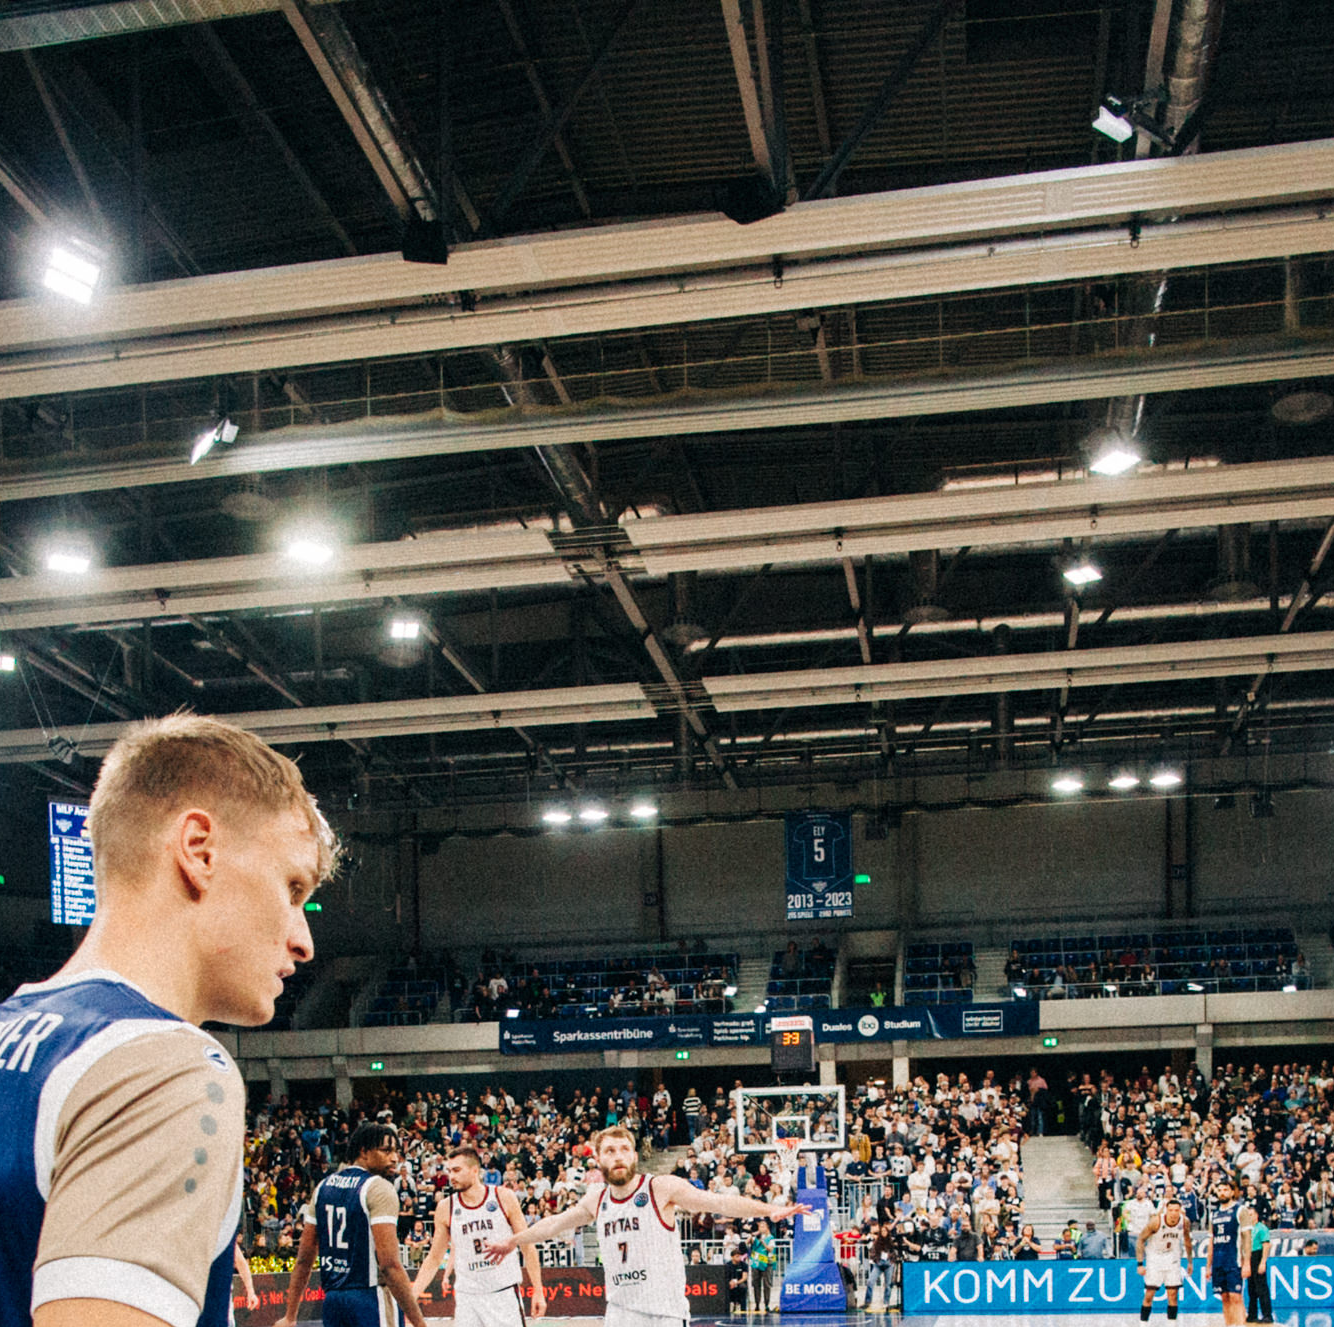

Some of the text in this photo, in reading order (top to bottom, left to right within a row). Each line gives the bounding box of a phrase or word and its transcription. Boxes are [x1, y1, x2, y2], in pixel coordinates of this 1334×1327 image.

[813, 826, 825, 836] ELY
[813, 838, 825, 862] 5
[787, 892, 852, 909] 2013 2023
[822, 1022, 853, 1032] Duales
[883, 1020, 921, 1029] Studium
[553, 1028, 654, 1044] Sparkassentribüne
[325, 1203, 349, 1250] 12
[461, 1218, 494, 1236] RYTAS
[604, 1217, 640, 1238] RYTAS
[617, 1242, 628, 1264] 7
[684, 1280, 718, 1297] oals
[785, 1283, 840, 1295] BE MORE
[923, 1265, 1055, 1304] KOMM
[1067, 1265, 1127, 1303] ZU
